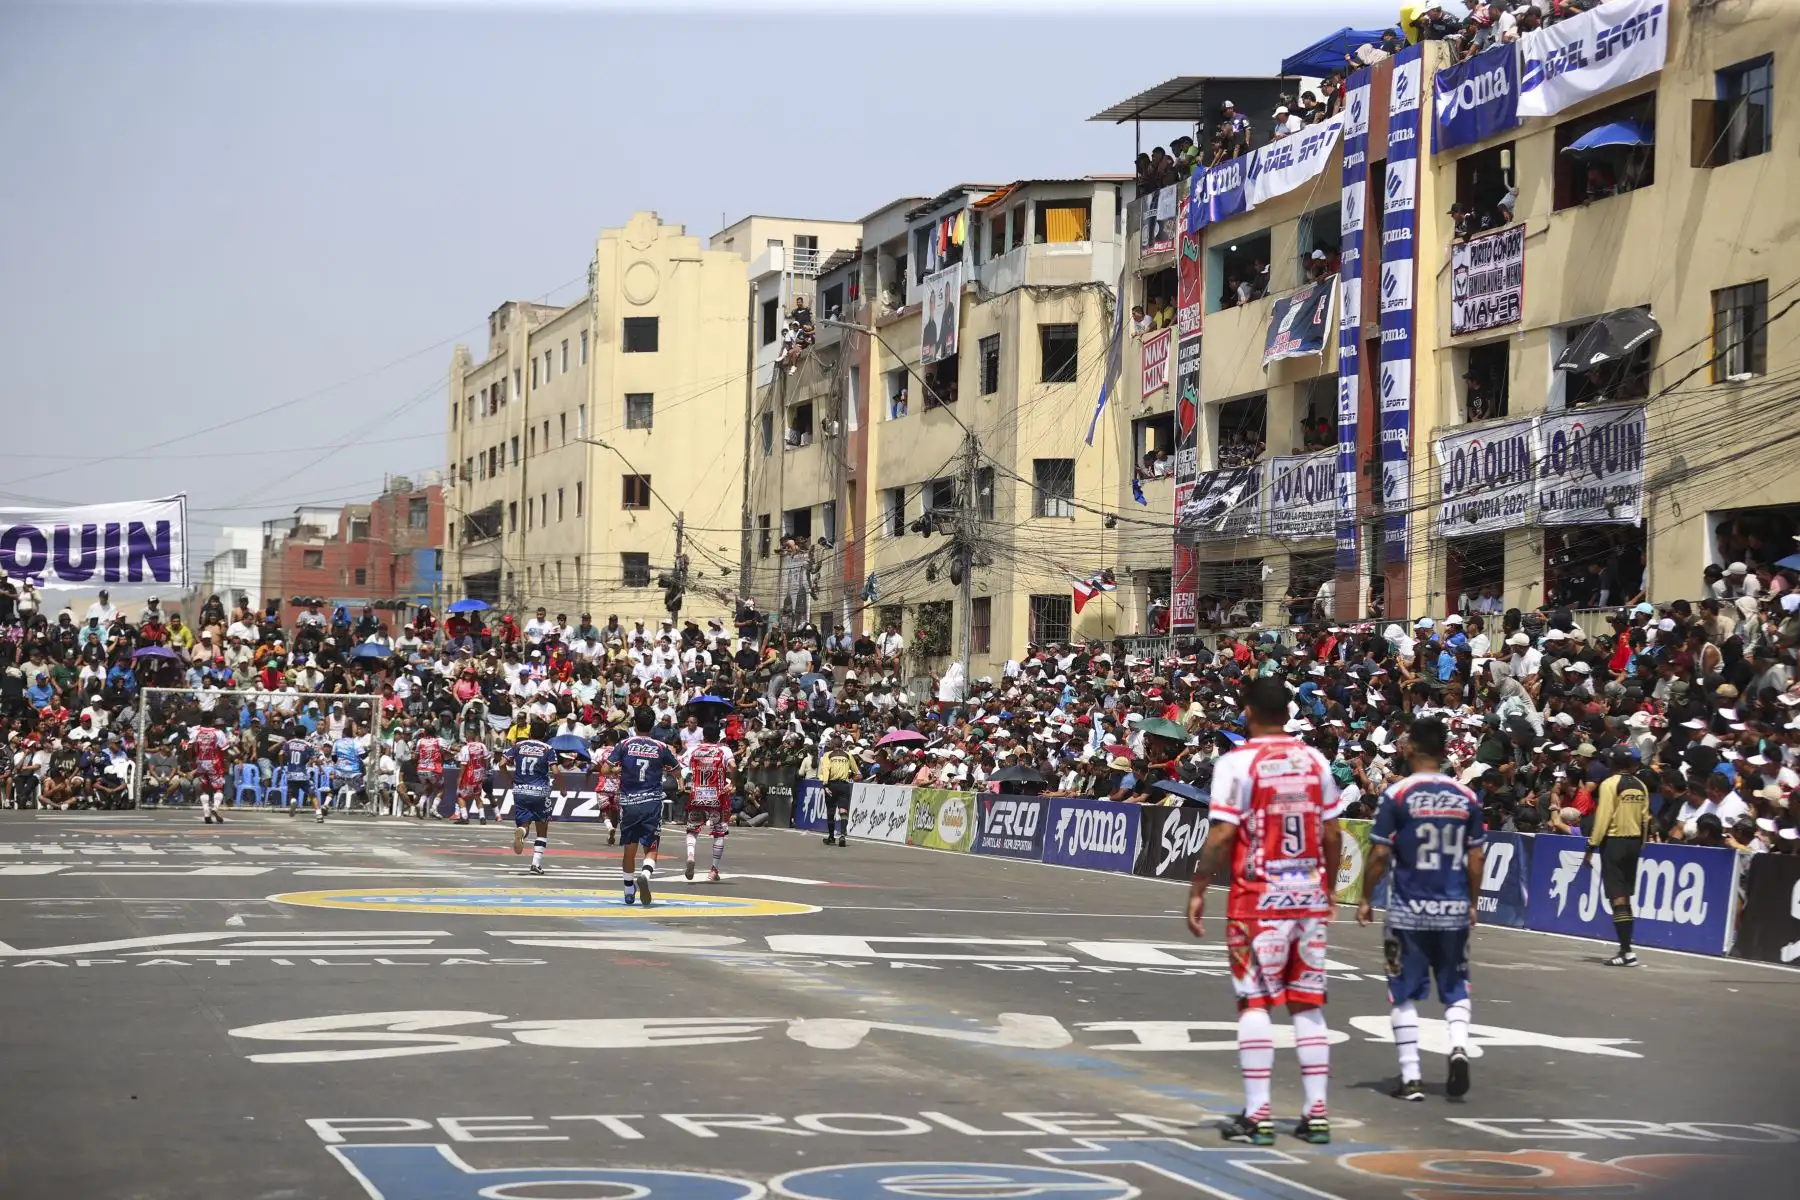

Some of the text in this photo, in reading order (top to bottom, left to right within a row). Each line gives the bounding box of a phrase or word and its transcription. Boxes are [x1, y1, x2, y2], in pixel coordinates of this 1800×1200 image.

[1545, 4, 1664, 80] GAEL SPORT
[1263, 143, 1294, 174] GAEL
[1493, 233, 1521, 262] CONDOR
[1464, 292, 1520, 327] MAYER
[1444, 436, 1531, 494] JOAQUIN
[1540, 422, 1642, 480] JOAQUIN
[1274, 463, 1336, 506] JOAQUIN
[1540, 490, 1556, 511] LA
[1559, 486, 1606, 511] VICTORIA
[0, 520, 172, 588] QUIN
[291, 751, 301, 765] 10
[521, 756, 538, 775] 17
[636, 758, 650, 782] 7
[984, 800, 1040, 837] VERCO
[1408, 792, 1469, 809] TEVEZ
[1069, 808, 1128, 857] Joma
[1156, 807, 1211, 876] SEND
[1283, 814, 1304, 856] 9
[1415, 822, 1467, 871] 24
[226, 1009, 1645, 1064] SENDA
